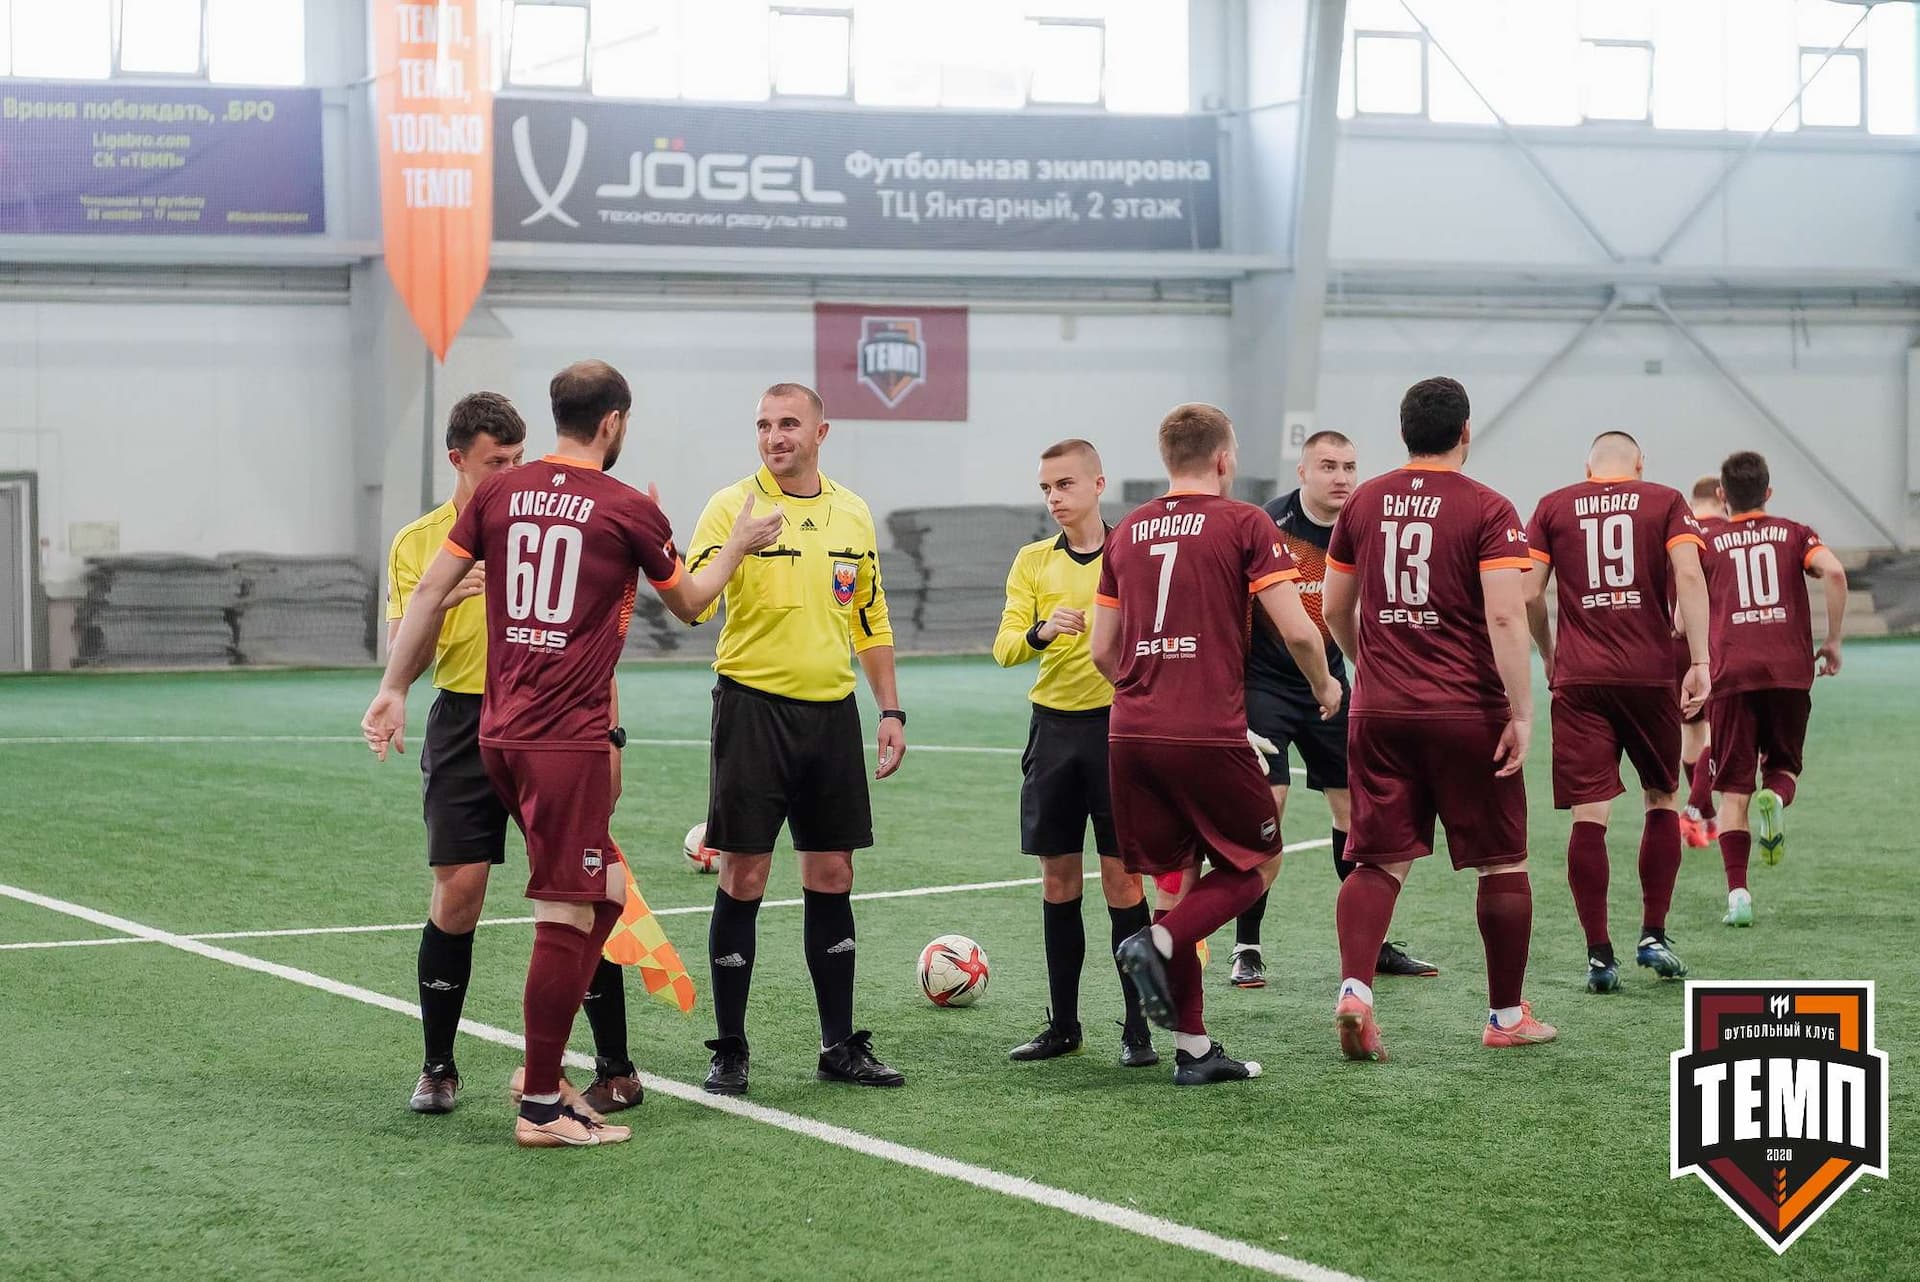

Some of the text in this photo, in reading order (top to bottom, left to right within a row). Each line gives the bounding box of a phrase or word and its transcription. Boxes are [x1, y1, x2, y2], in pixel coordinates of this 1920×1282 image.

[3, 97, 275, 123] Время побеждать, .БРО
[92, 132, 190, 150] Ligabro.com
[388, 113, 484, 155] ТОЛЬКО
[92, 152, 115, 168] СК
[596, 138, 846, 203] JÖGEL
[845, 151, 1211, 186] Футбольная экипировка
[402, 168, 472, 208] ТЕМП!
[598, 209, 848, 230] технологии результата
[876, 190, 1183, 225] ТЦ Янтарный, 2 этаж
[863, 342, 919, 373] ТЕМП
[508, 490, 595, 524] КИСЕЛЕВ
[1383, 494, 1442, 518] СЫЧЕВ
[1574, 493, 1640, 516] ШИБАЕВ
[1130, 513, 1206, 544] ТАРАСОВ
[1713, 525, 1788, 553] АПАЛЬКИН
[1380, 521, 1433, 606] 13
[1580, 513, 1636, 589] 19
[506, 521, 583, 624] 60
[1150, 541, 1178, 633] 7
[1729, 542, 1780, 608] 10
[1581, 590, 1641, 609] SEUS
[1379, 608, 1439, 625] SEUS
[1731, 607, 1786, 624] SEUS
[505, 626, 568, 648] SEUS
[1135, 636, 1197, 657] SEUS
